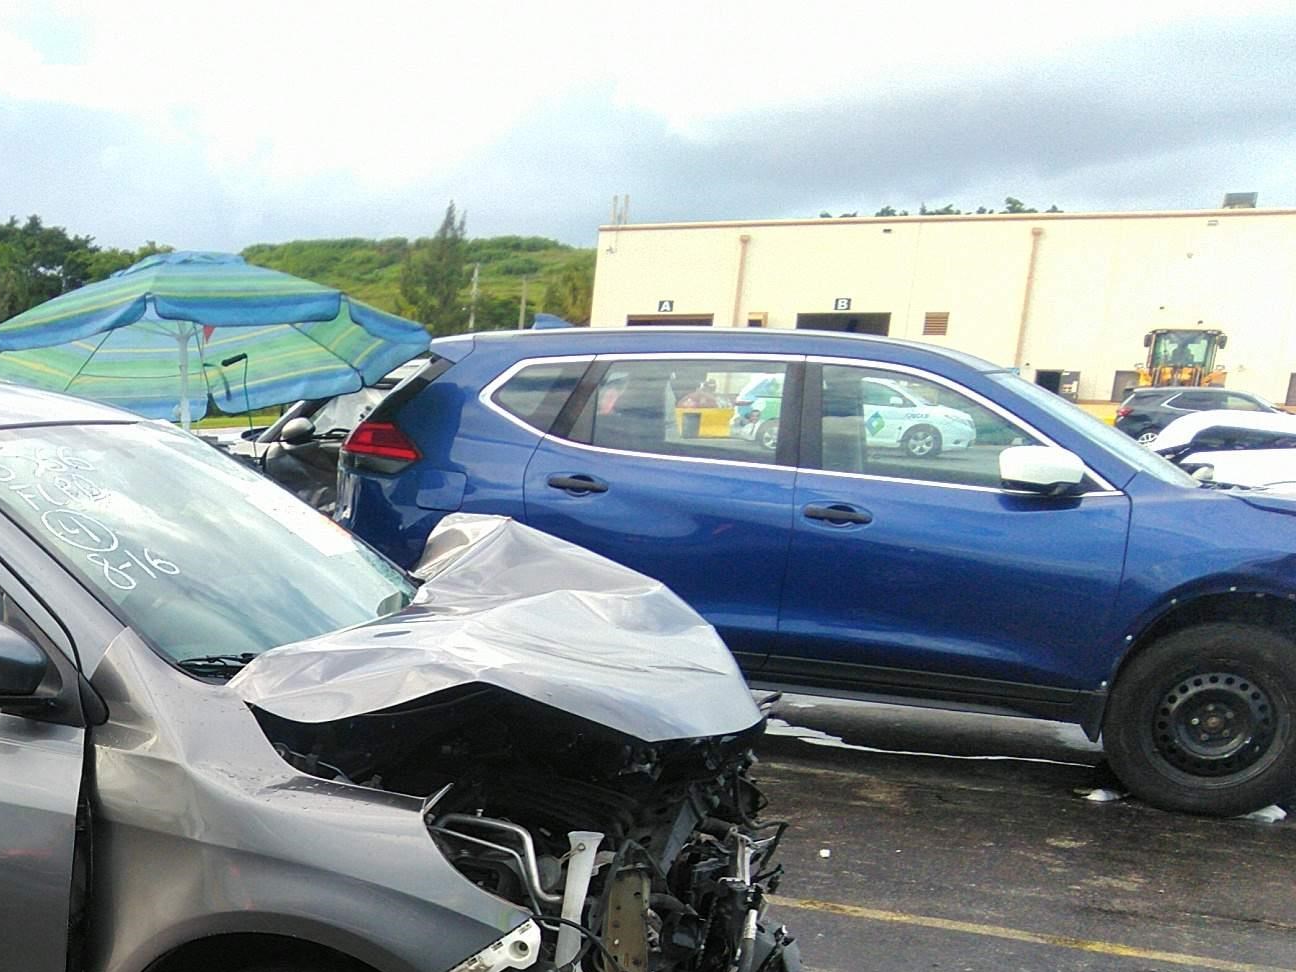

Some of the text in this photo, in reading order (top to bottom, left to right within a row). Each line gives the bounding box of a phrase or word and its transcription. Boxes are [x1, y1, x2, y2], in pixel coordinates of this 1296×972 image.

[659, 300, 672, 312] A
[837, 298, 850, 310] B
[87, 547, 181, 590] 8-16
